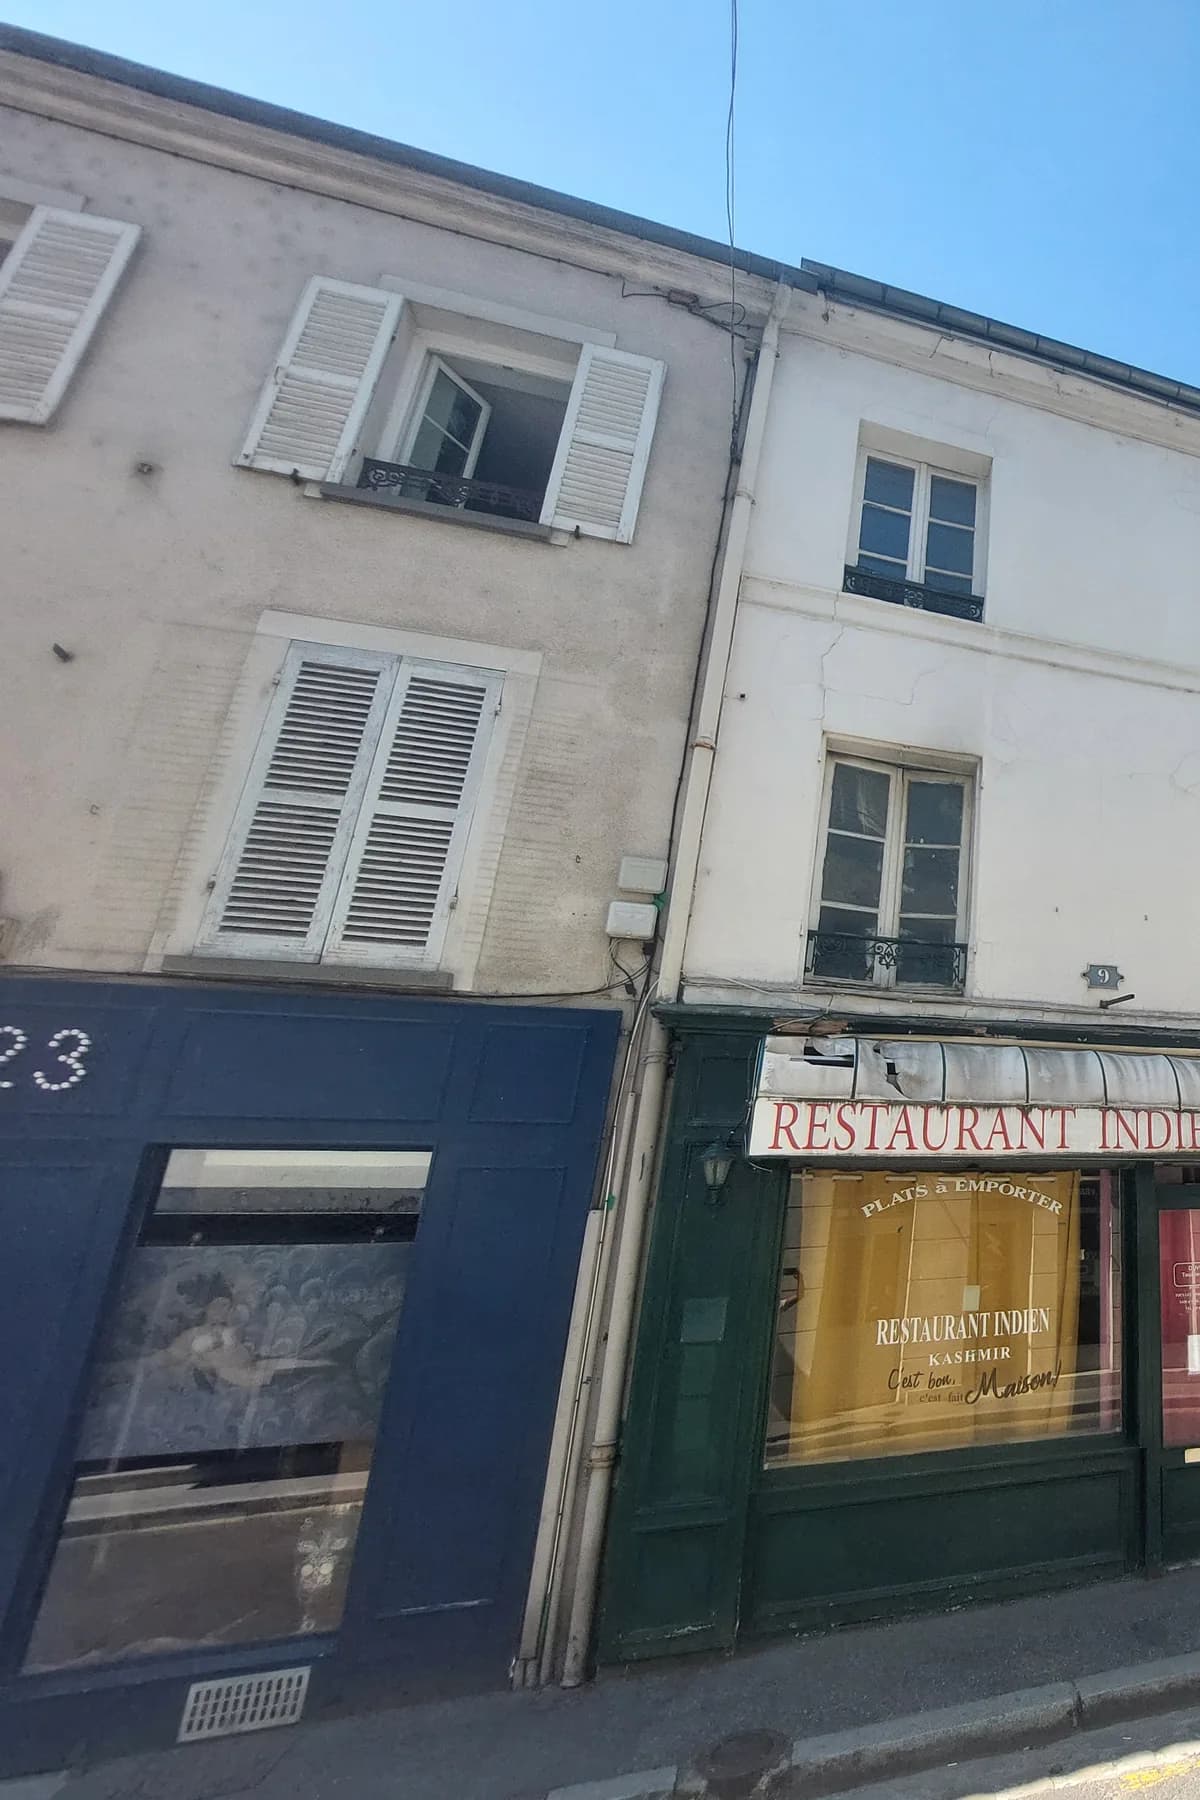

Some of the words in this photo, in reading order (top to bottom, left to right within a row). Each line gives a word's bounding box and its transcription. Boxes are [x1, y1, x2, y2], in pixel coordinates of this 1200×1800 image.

[1098, 968, 1110, 984] 9
[768, 1102, 1077, 1151] RESTAURANT
[860, 1183, 929, 1219] PLATS
[935, 1183, 949, 1194] à
[955, 1179, 1064, 1216] EMPORTER
[875, 1312, 991, 1346] RESTAURANT
[993, 1307, 1051, 1337] INDIEN
[928, 1346, 1012, 1367] KASHMIR
[888, 1367, 924, 1390] C'est
